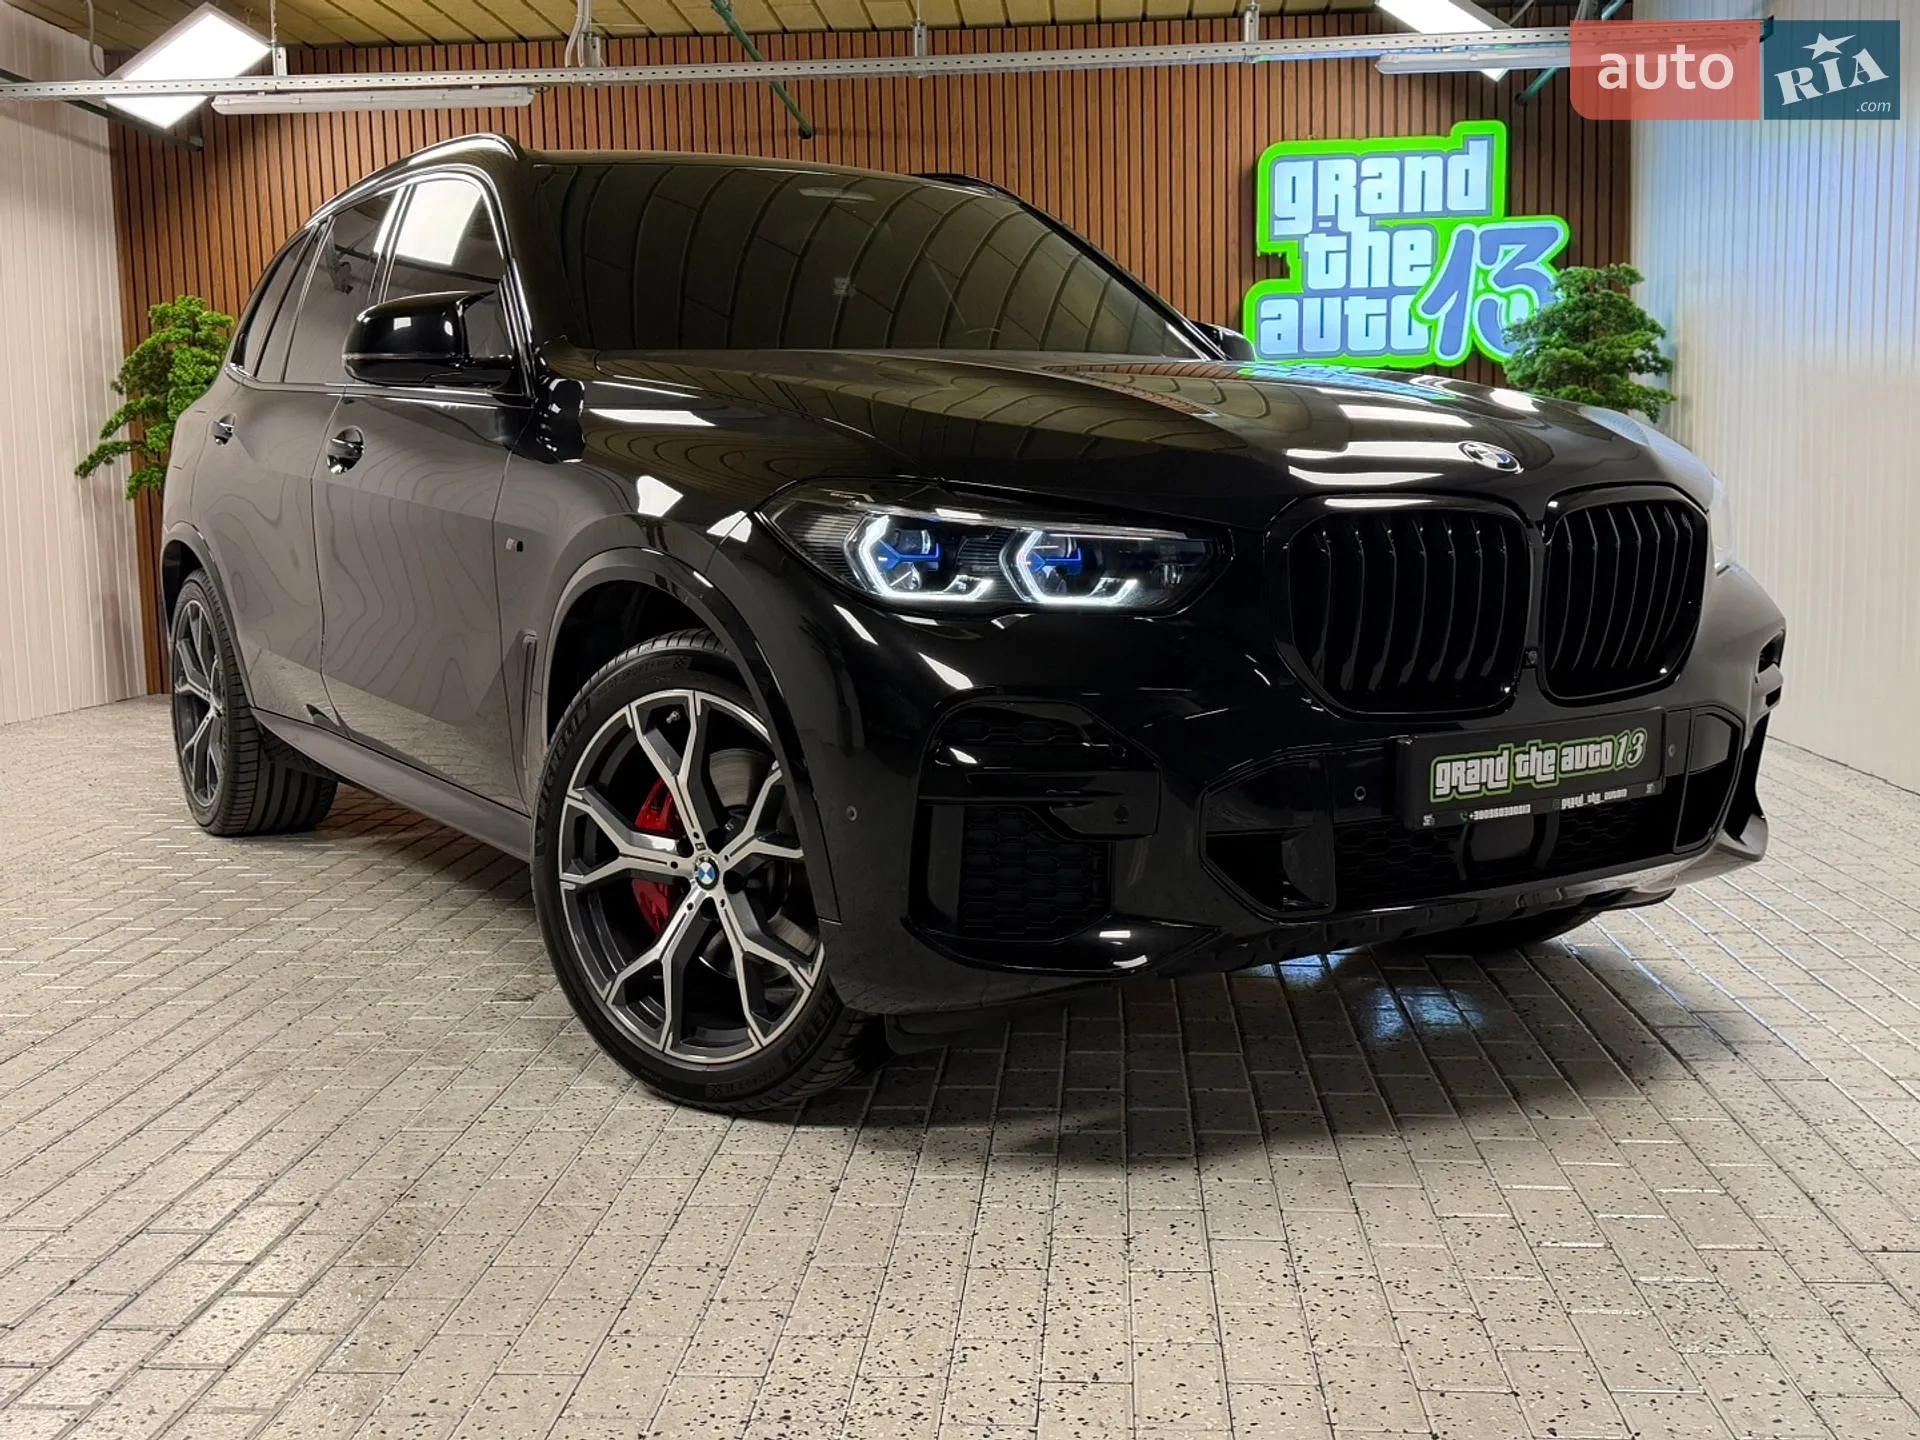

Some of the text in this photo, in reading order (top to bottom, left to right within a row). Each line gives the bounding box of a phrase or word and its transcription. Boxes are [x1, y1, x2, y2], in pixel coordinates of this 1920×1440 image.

[1303, 216, 1433, 290] the
[1259, 222, 1562, 361] auto 13
[1514, 746, 1556, 783] the
[1561, 741, 1613, 772] auto
[1615, 731, 1645, 767] 13
